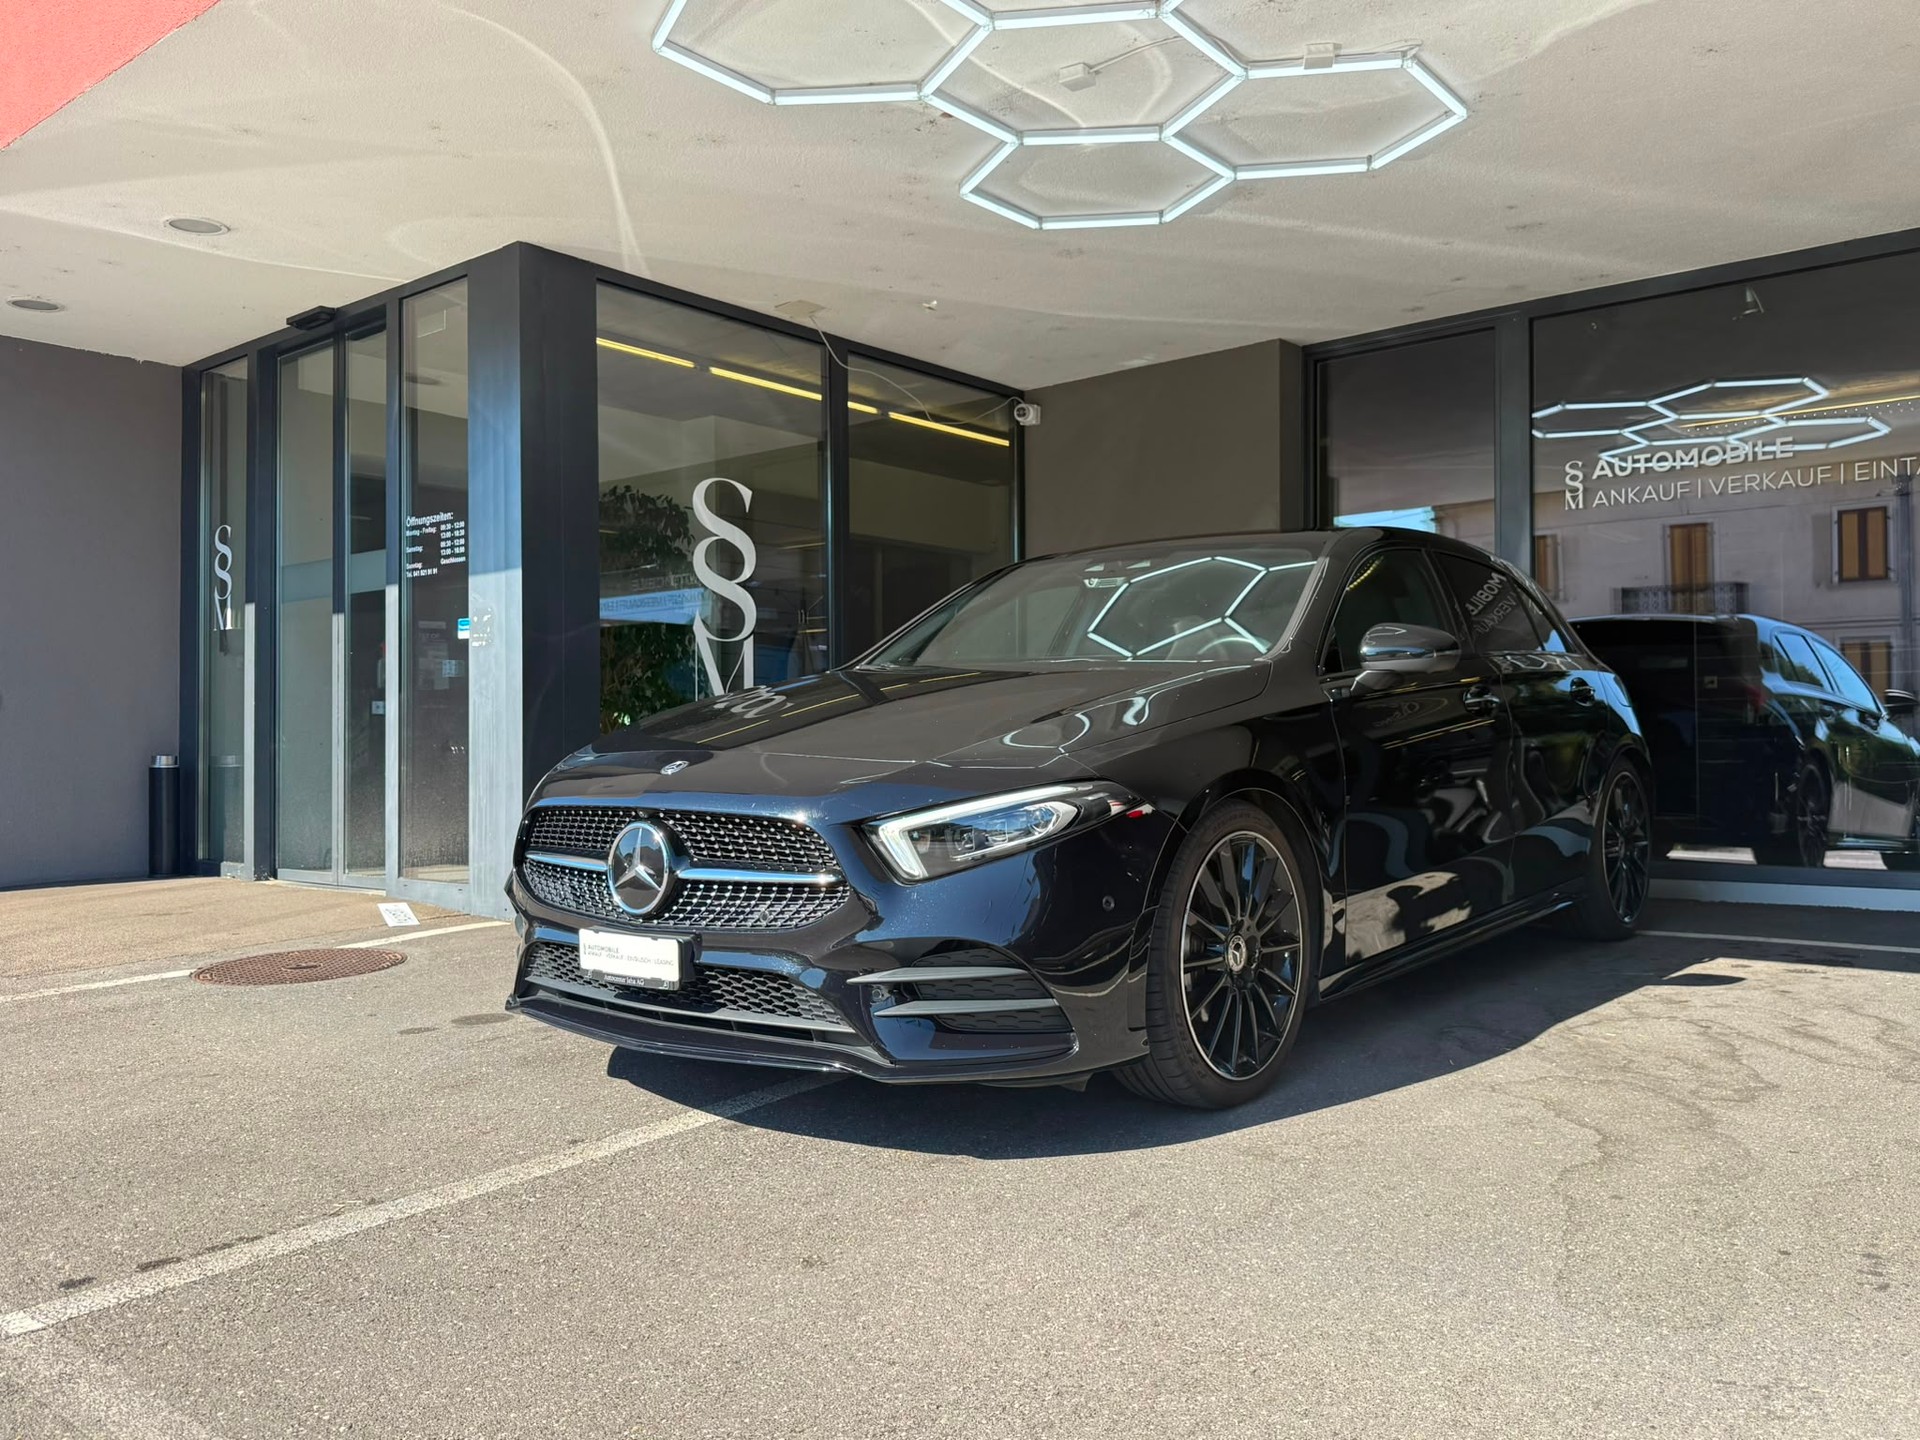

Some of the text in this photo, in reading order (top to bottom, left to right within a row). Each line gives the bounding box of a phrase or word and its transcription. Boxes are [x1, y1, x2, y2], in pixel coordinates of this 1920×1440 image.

[1592, 436, 1794, 480] AUTOMOBILE
[1592, 480, 1690, 508] ANKAUF
[1709, 465, 1833, 495] VERKAUF
